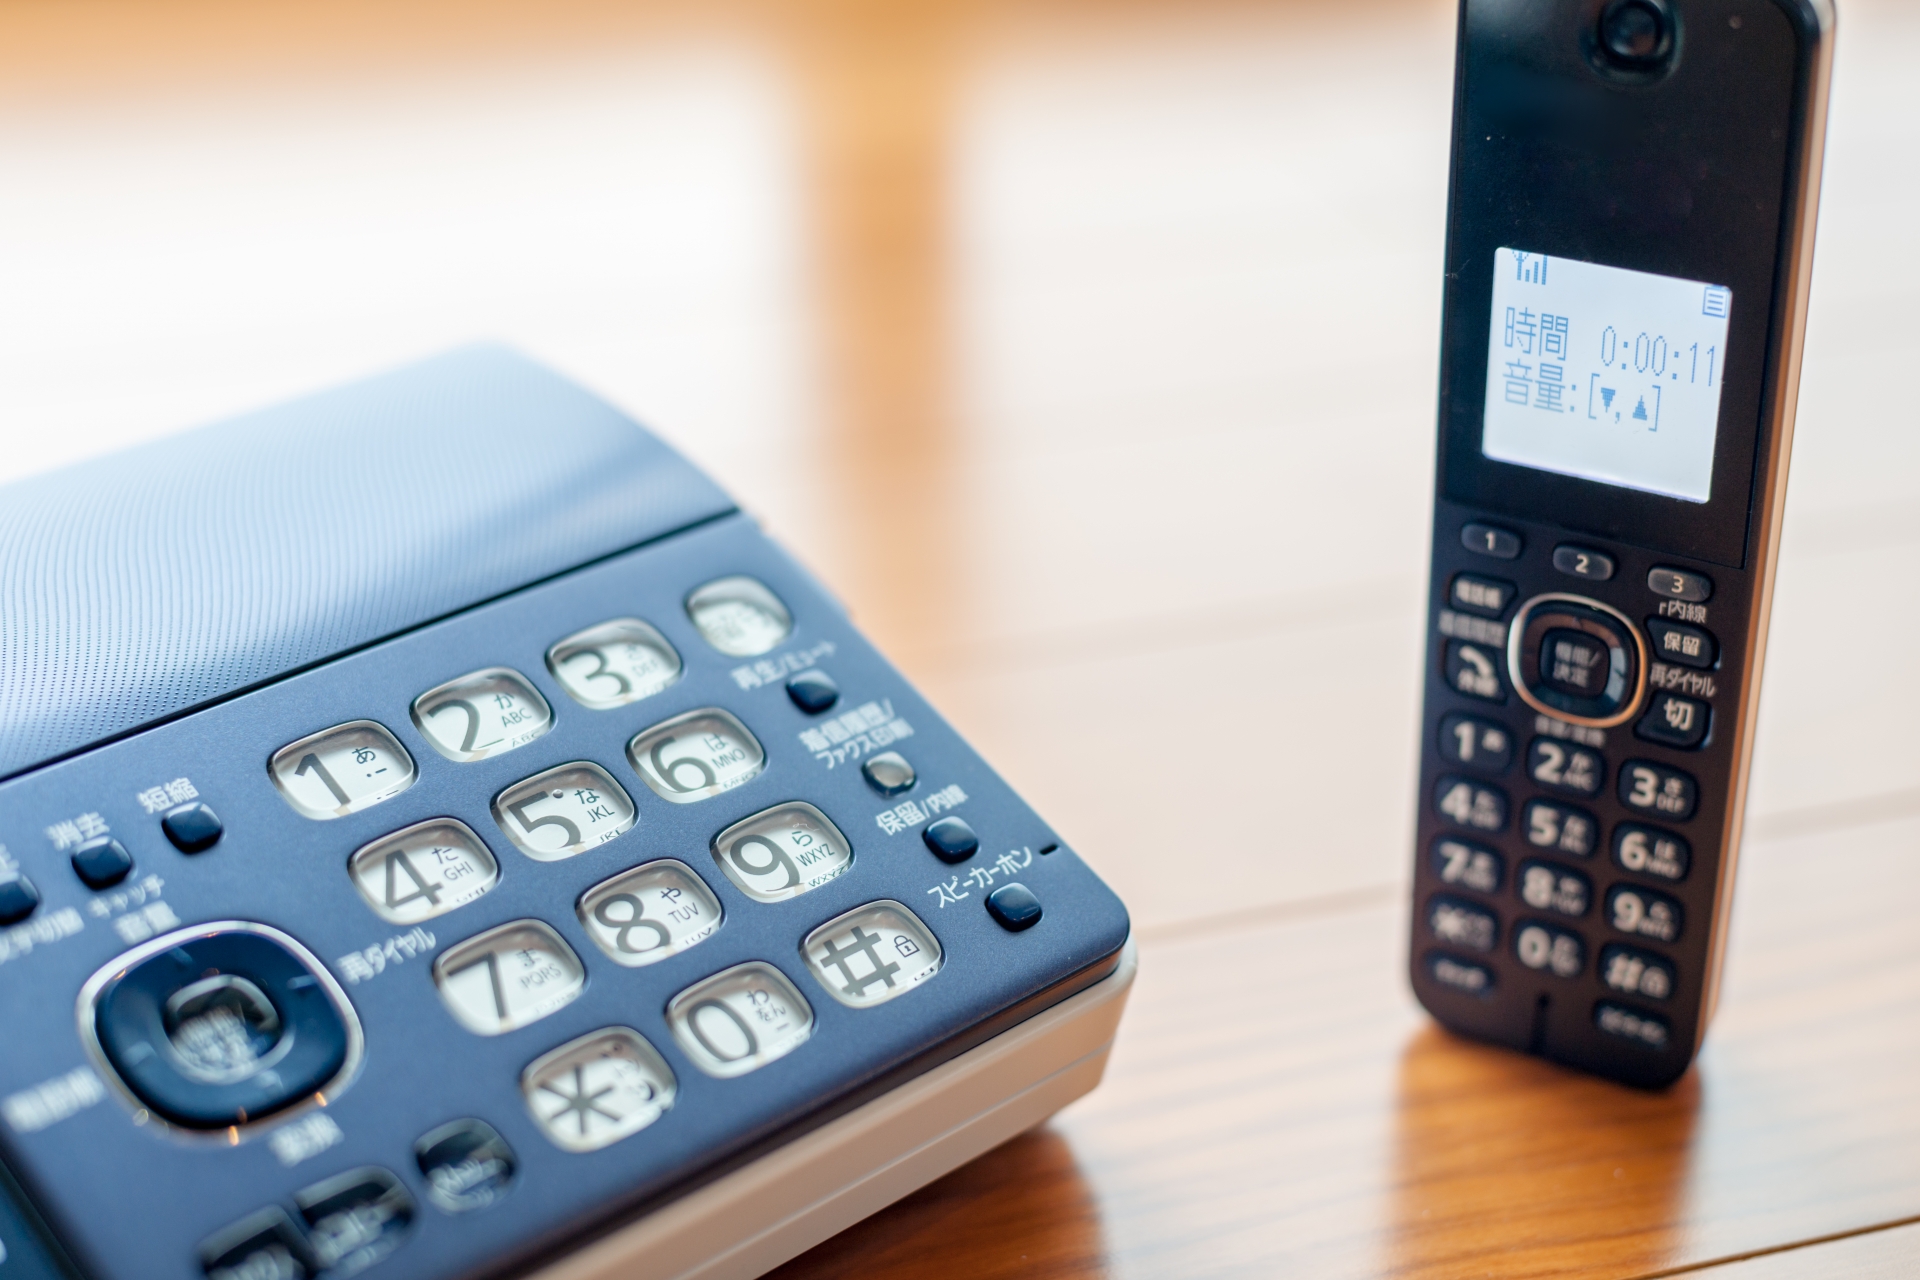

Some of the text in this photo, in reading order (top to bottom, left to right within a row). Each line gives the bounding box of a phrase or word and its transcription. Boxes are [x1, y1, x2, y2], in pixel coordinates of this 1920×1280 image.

[1504, 306, 1715, 387] 時間 0:00:11
[1485, 531, 1496, 551] 1
[1574, 554, 1589, 574] 2
[1671, 575, 1684, 594] 3
[1663, 631, 1700, 656] 保留
[561, 646, 631, 697] 3
[1649, 662, 1717, 698] 再ダイヤル
[494, 692, 514, 710] か
[501, 707, 532, 727] ABC
[1664, 699, 1694, 731] 切
[426, 699, 504, 752] 2
[703, 733, 728, 751] は
[1454, 721, 1475, 761] 1
[352, 746, 377, 765] あ
[650, 736, 717, 793] 6
[711, 749, 746, 770] MNO
[1534, 742, 1564, 784] 2
[137, 777, 200, 814] 短縮
[295, 752, 351, 807] 1
[574, 787, 601, 805] な
[1629, 767, 1658, 807] 3
[507, 790, 585, 850] 5
[586, 804, 616, 823] JKL
[875, 783, 969, 837] 保留/内線
[1440, 783, 1470, 824] 4
[791, 830, 814, 847] ら
[1529, 805, 1560, 846] 5
[431, 847, 459, 865] た
[729, 834, 804, 892] 9
[795, 843, 835, 867] WXYZ
[1439, 841, 1470, 883] 7
[1619, 831, 1648, 871] 6
[384, 849, 444, 910] 4
[443, 861, 475, 882] GHI
[927, 846, 1032, 909] スピーカーホン
[1522, 866, 1555, 909] 8
[660, 886, 683, 905] や
[667, 901, 700, 924] TUV
[1613, 892, 1644, 932] 9
[594, 892, 672, 954] 8
[1517, 926, 1551, 969] 0
[446, 951, 510, 1022] 7
[519, 962, 563, 989] PQRS
[687, 997, 759, 1063] 0
